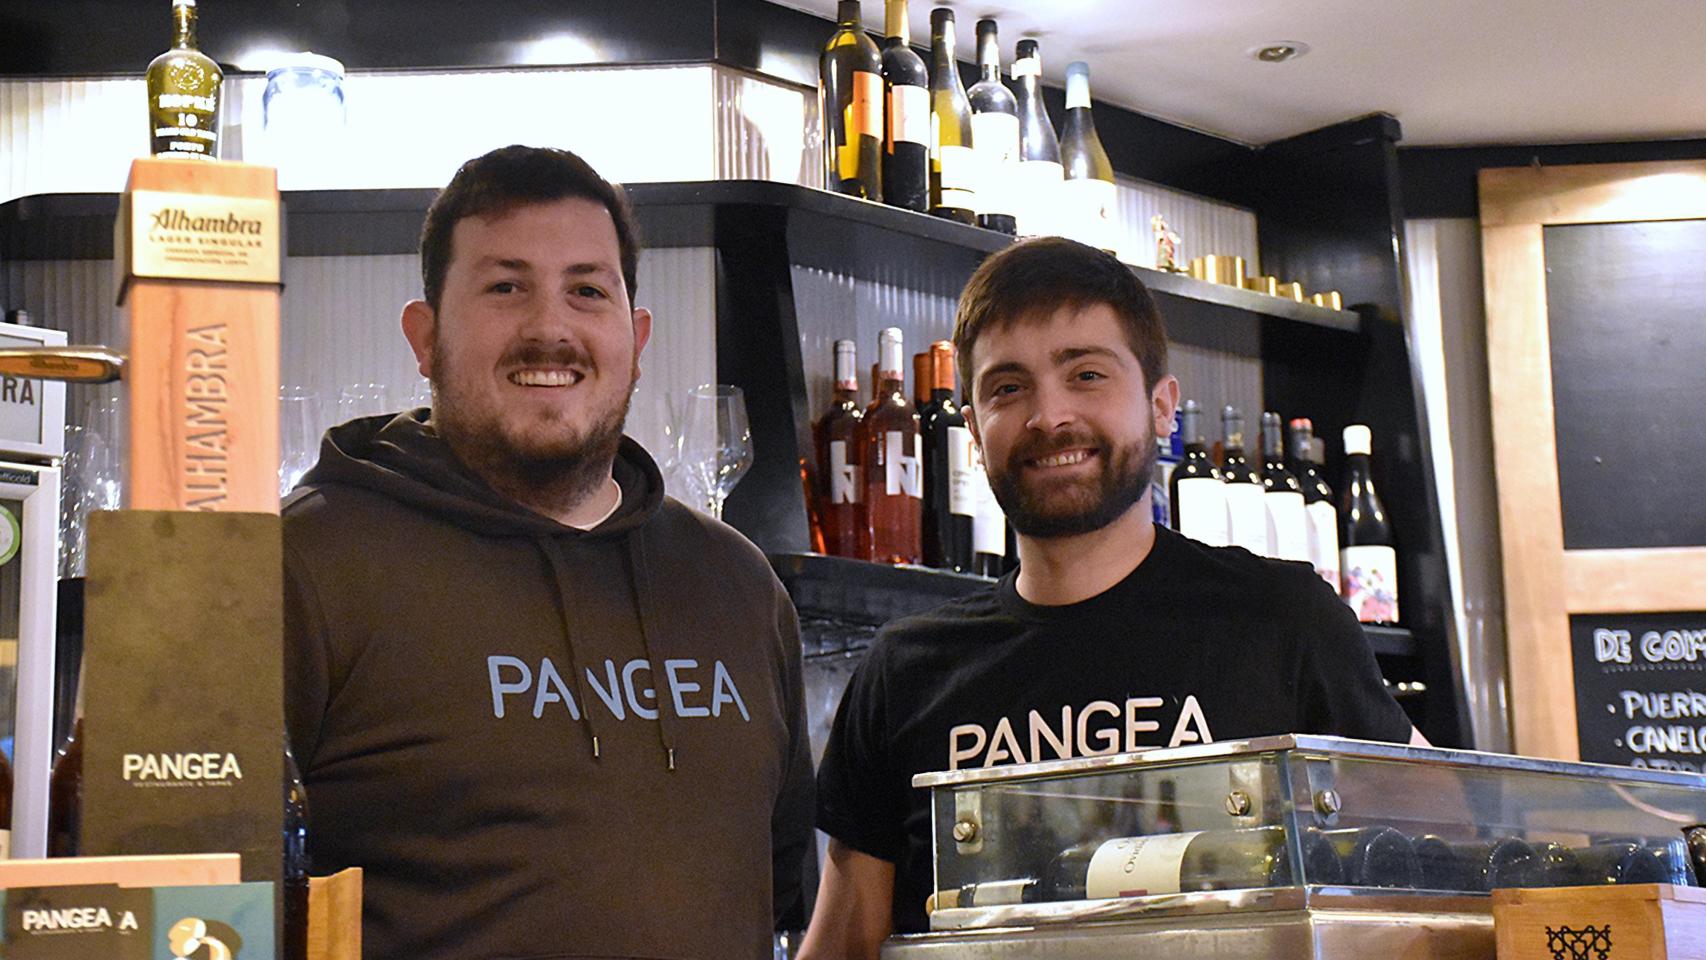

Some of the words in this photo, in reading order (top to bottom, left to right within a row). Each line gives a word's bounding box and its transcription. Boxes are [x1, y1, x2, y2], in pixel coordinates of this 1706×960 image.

[150, 208, 262, 235] Alhambra
[185, 322, 228, 512] ALHAMBRA
[1593, 628, 1632, 663] DE
[487, 655, 751, 722] PANGEA
[1620, 689, 1706, 720] PUERR
[949, 694, 1214, 771] PANGEA
[123, 752, 243, 781] PANGEA
[22, 906, 113, 931] PANGEA
[117, 910, 139, 930] A
